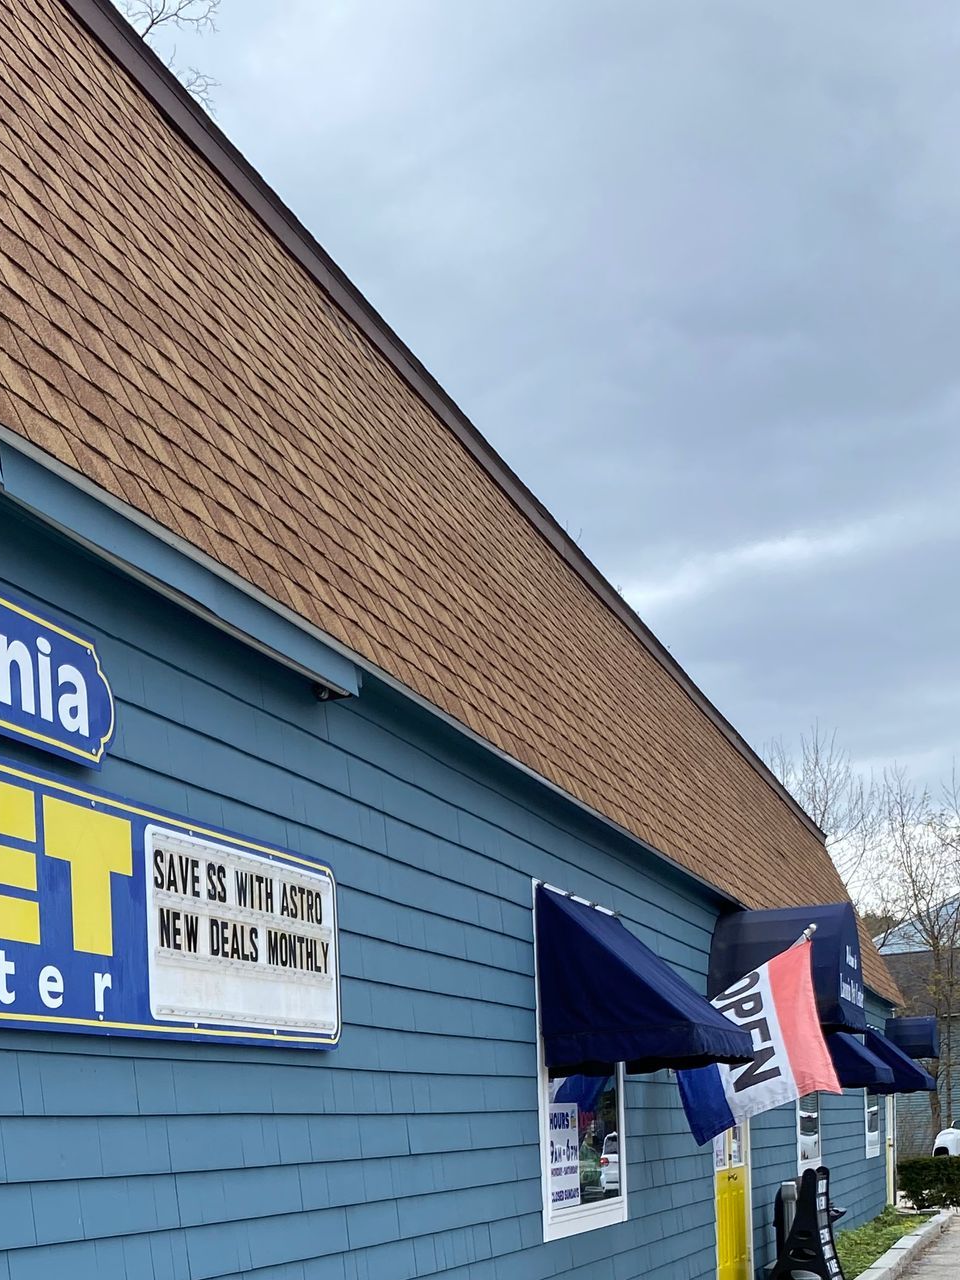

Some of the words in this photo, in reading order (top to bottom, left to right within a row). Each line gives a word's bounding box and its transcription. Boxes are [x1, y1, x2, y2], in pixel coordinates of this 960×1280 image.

[153, 849, 201, 899] SAVE
[234, 870, 275, 914] WITH
[279, 882, 324, 926] ASTRO
[159, 907, 199, 954] NEW
[209, 917, 259, 963] DEALS
[267, 929, 330, 975] MONTHLY
[714, 970, 782, 1094] OPEN
[549, 1111, 570, 1130] HOURS
